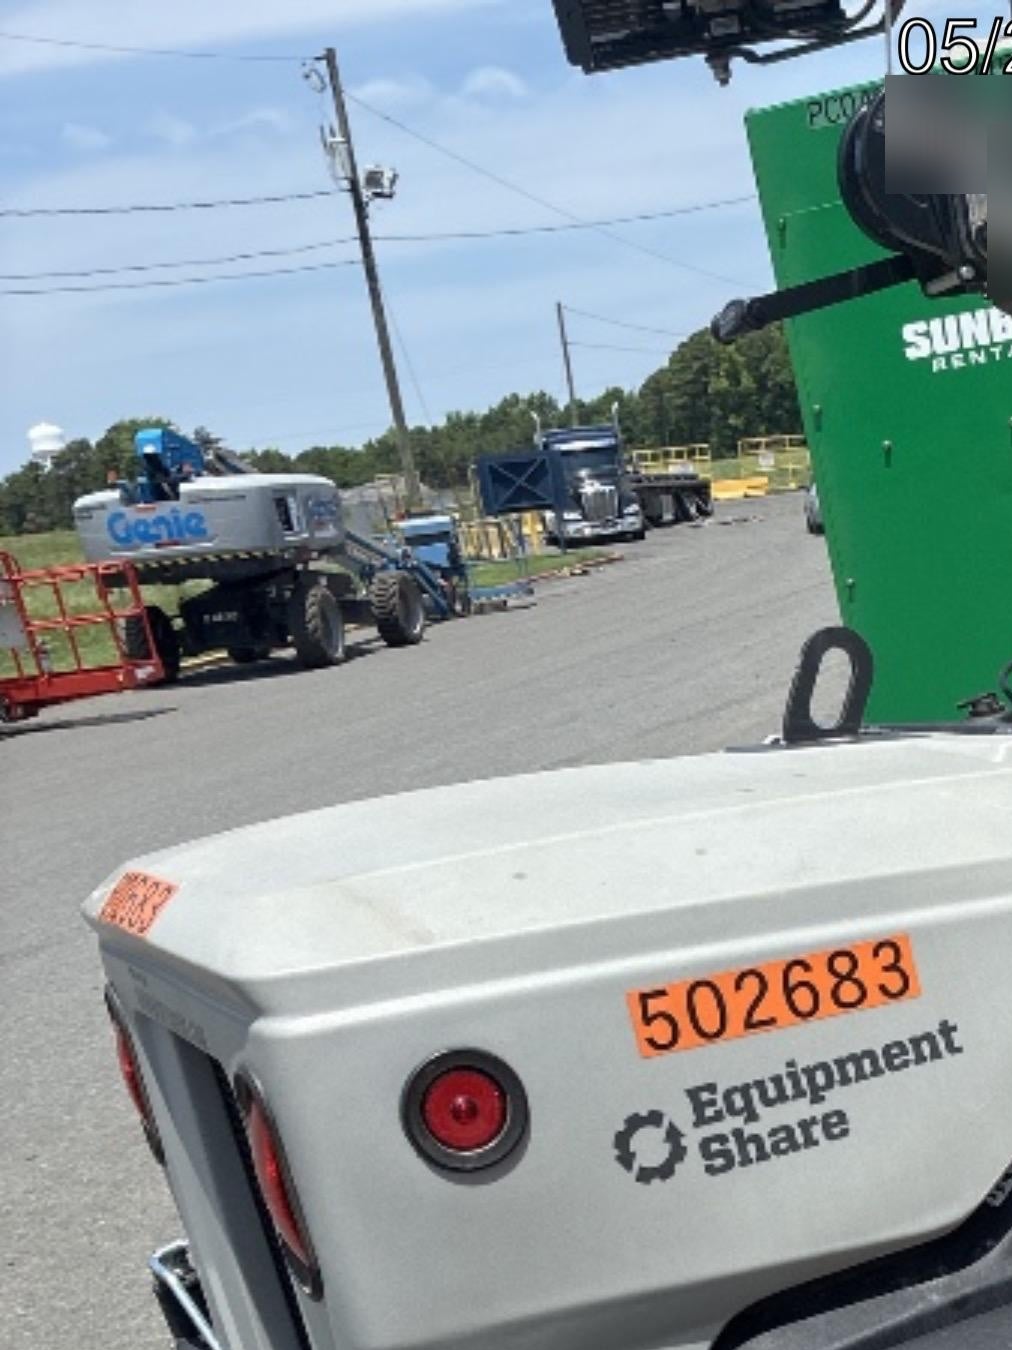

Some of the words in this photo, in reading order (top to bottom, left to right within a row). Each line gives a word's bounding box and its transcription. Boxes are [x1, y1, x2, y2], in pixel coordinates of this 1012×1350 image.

[107, 506, 208, 545] Genie
[638, 939, 910, 1052] 502683
[685, 1019, 963, 1129] Equipment
[699, 1108, 850, 1177] Share
